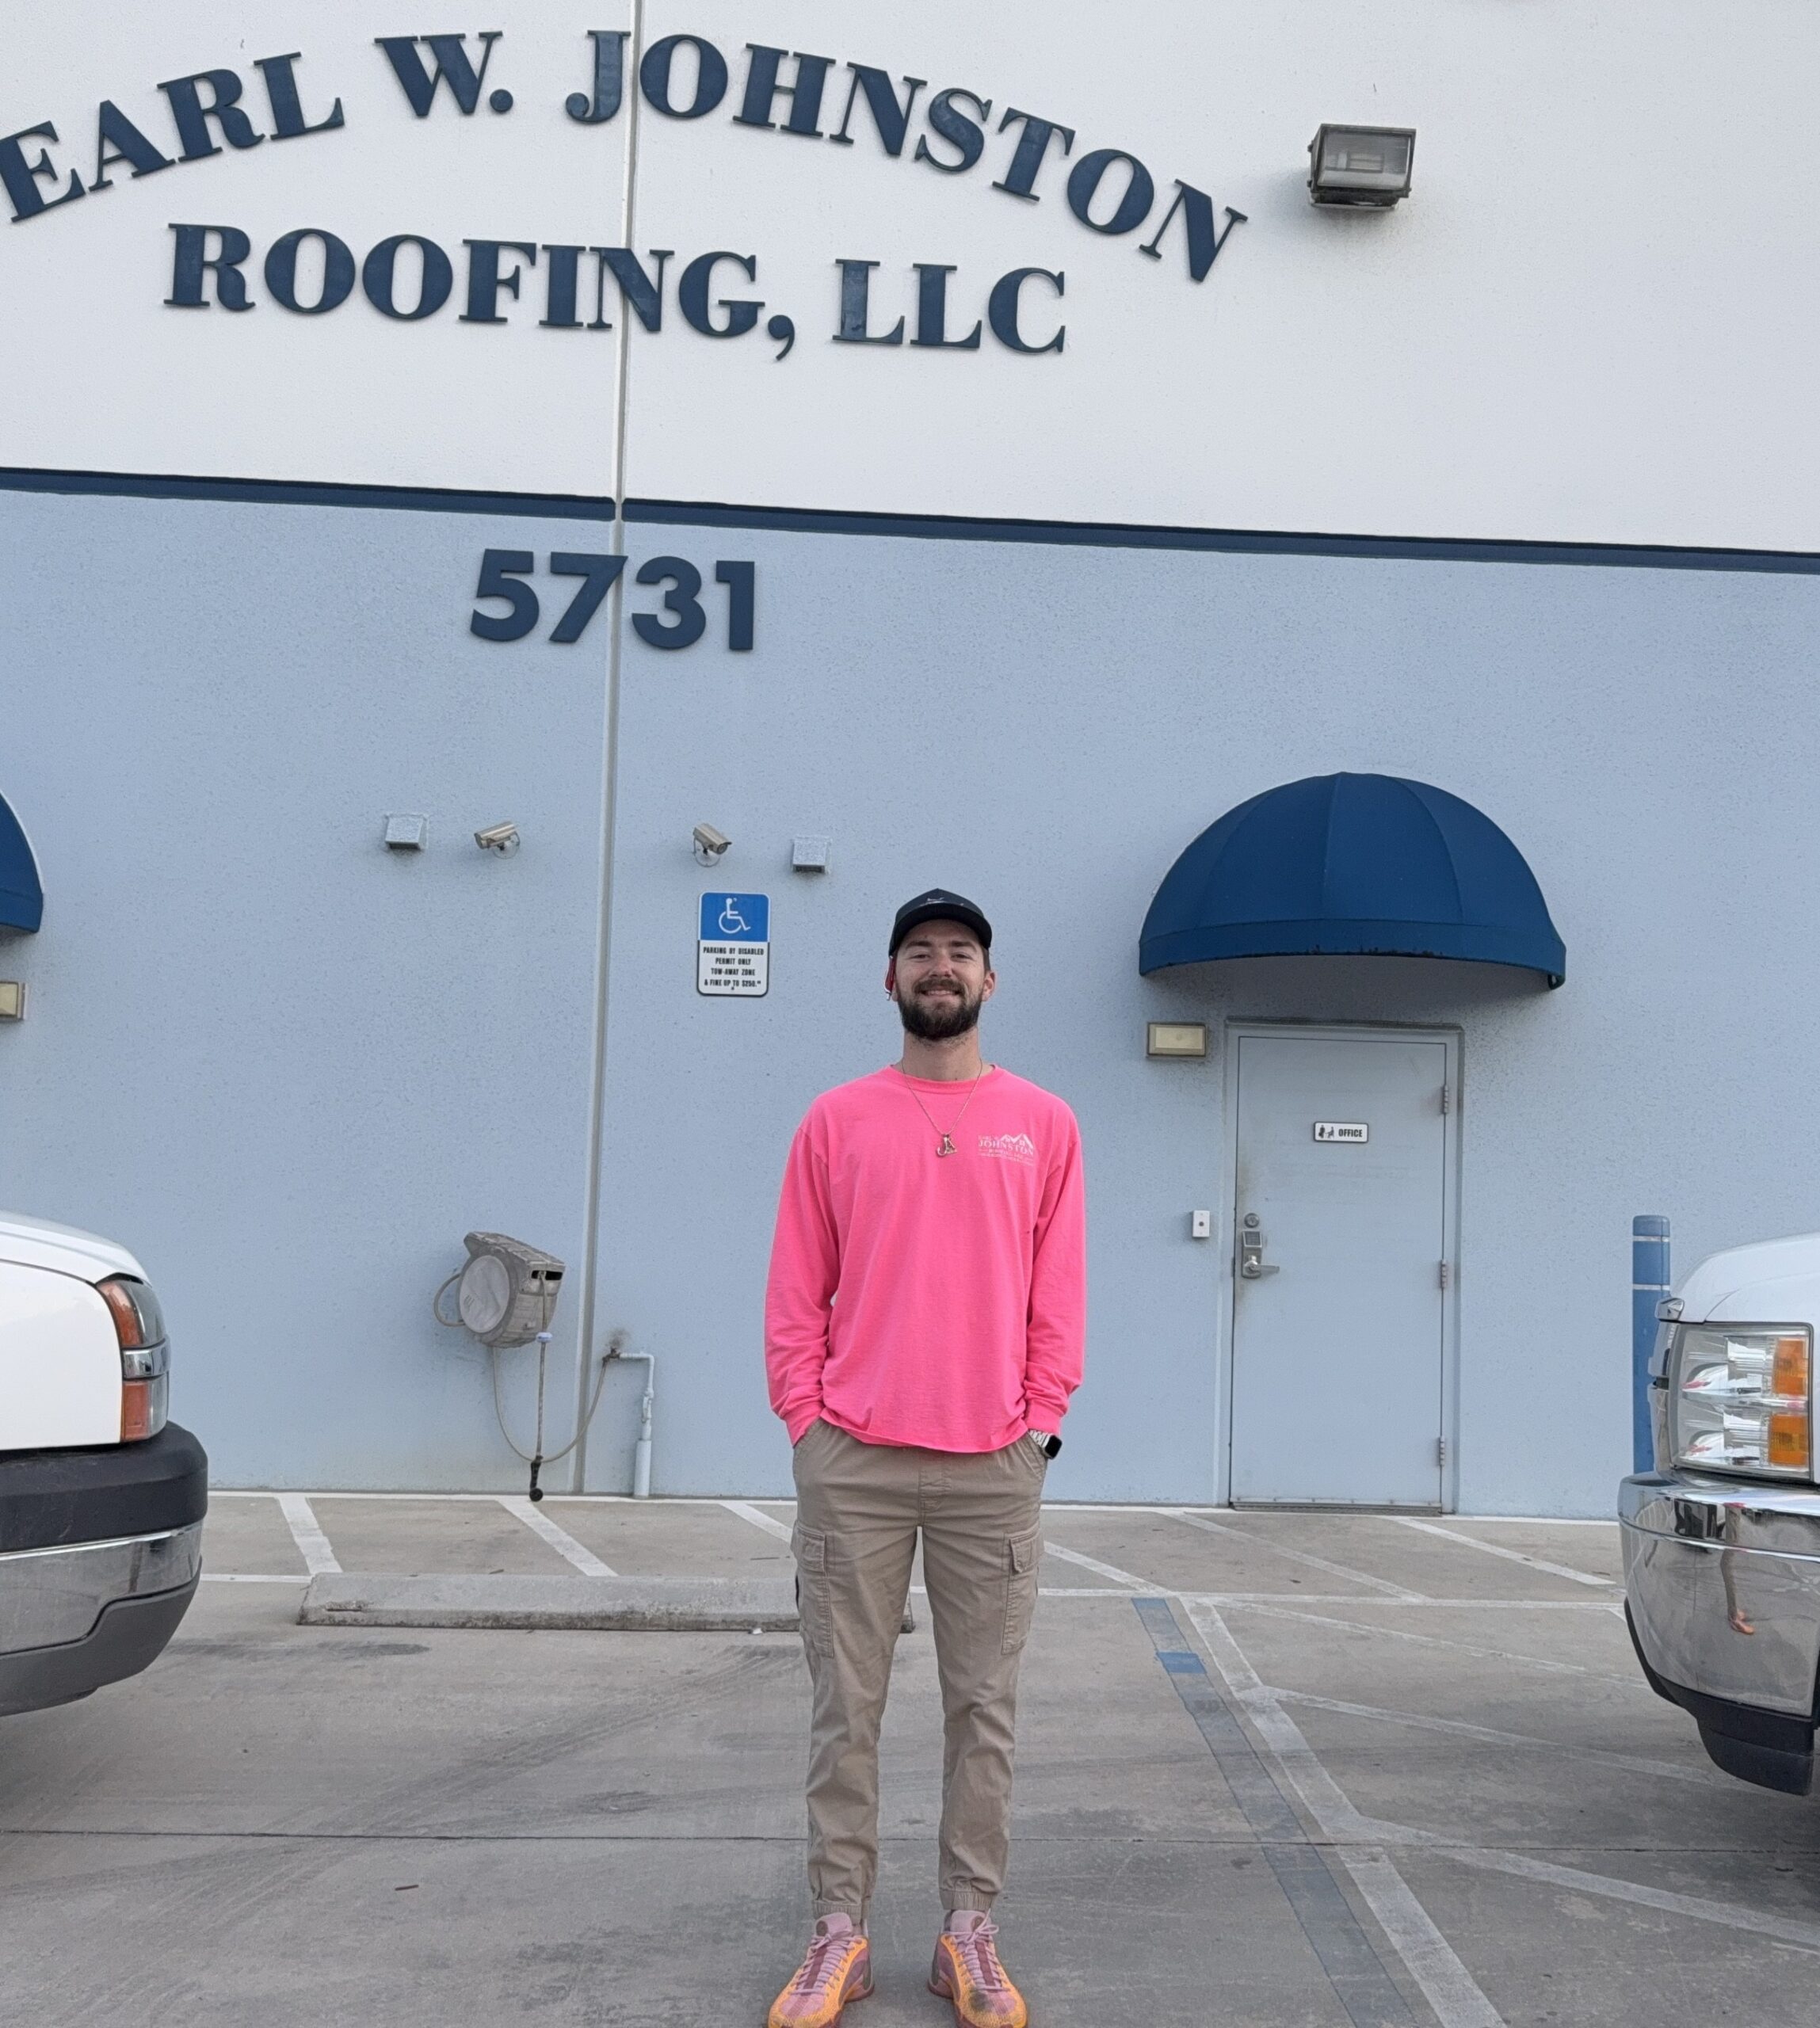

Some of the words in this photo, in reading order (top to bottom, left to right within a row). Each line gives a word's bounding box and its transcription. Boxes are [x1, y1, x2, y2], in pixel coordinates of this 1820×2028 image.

[0, 51, 345, 223] EARL
[373, 31, 513, 118] W.
[565, 29, 1248, 283] JOHNSTON
[163, 223, 795, 360] ROOFING,
[832, 259, 1066, 355] LLC
[470, 548, 755, 650] 5731
[979, 1140, 1033, 1154] JOHNSTON
[1338, 1128, 1362, 1138] OFFICE
